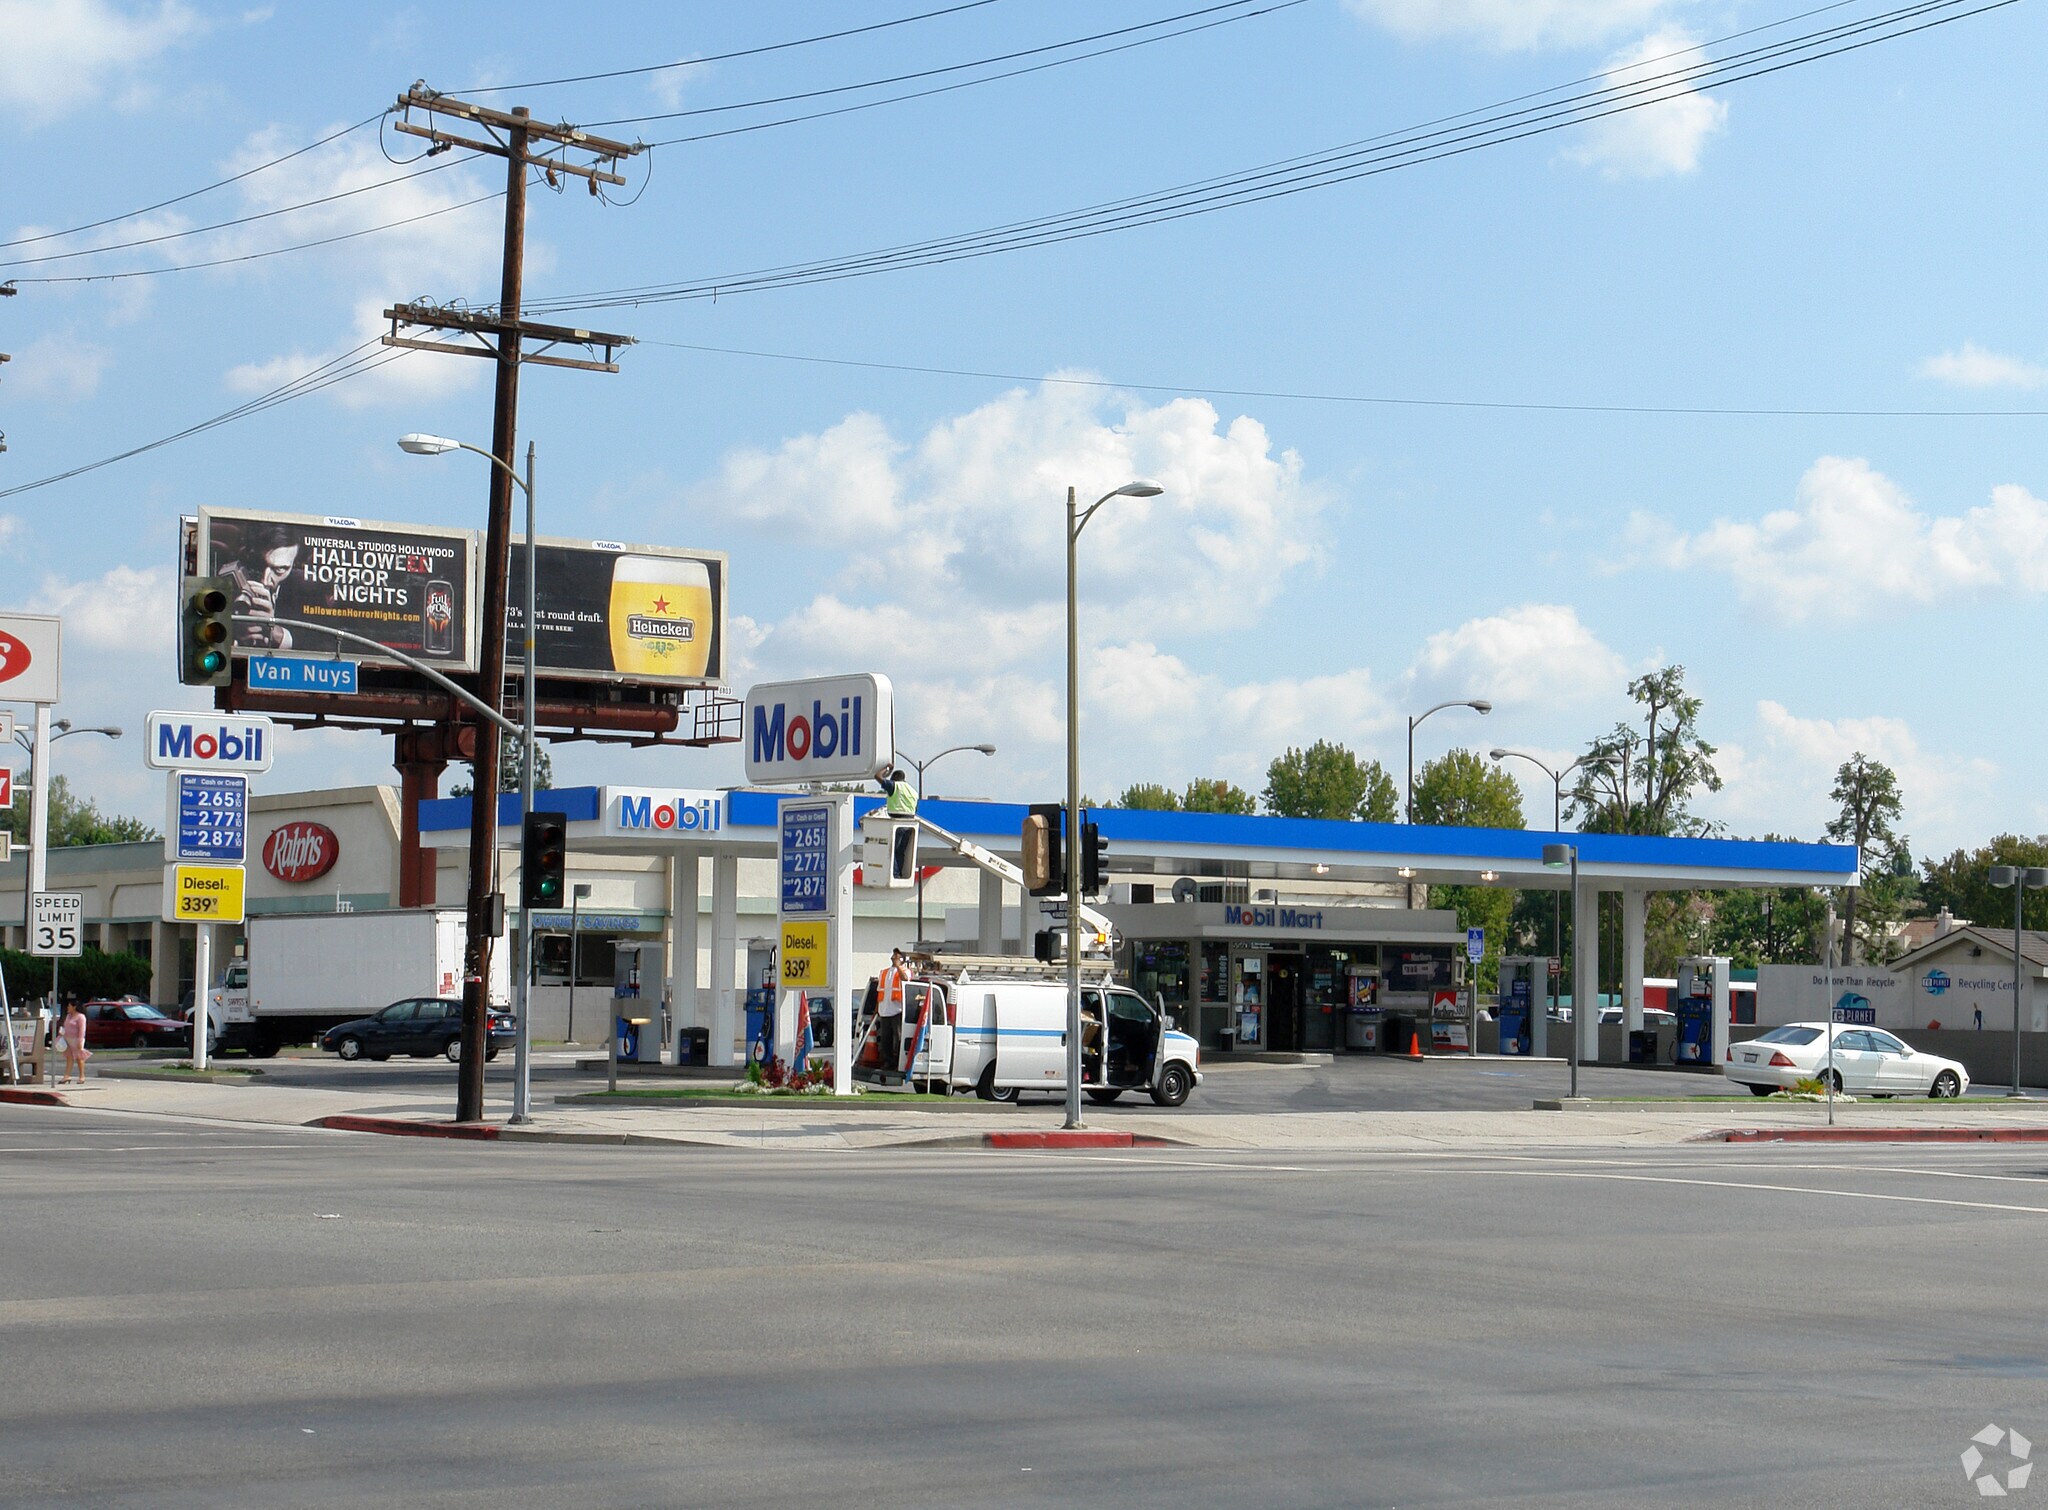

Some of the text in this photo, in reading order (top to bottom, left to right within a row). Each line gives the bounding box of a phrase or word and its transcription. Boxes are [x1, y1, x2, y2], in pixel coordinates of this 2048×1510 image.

[329, 518, 356, 526] VIACOM
[304, 536, 455, 558] UNIVERSAL STUDIOS HOLLYWOOD
[313, 547, 433, 573] HALLOWEEN
[303, 564, 389, 587] HORROR
[333, 583, 408, 606] NIGHTS
[303, 604, 420, 622] HalloweenHorrorNights.com
[547, 610, 575, 621] round
[577, 611, 604, 623] draft.
[632, 619, 690, 637] Heineken
[255, 661, 351, 688] Van Nuys
[753, 695, 862, 763] Mobil
[159, 723, 263, 762] Mobil
[198, 790, 235, 807] 2.65
[198, 810, 235, 827] 2.77
[619, 795, 721, 831] Mobil
[197, 830, 235, 847] 2.87
[795, 828, 820, 847] 2.65
[181, 849, 211, 857] Gasoline
[269, 826, 324, 877] Ralphs
[794, 853, 820, 871] 2.77
[184, 877, 224, 890] Diesel
[794, 876, 820, 896] 2.87
[35, 898, 80, 908] SPEED
[39, 912, 75, 922] LIMIT
[532, 913, 641, 929] OWNEY SAVINGS
[1225, 905, 1323, 929] Mobil Mart
[37, 927, 76, 949] 35
[785, 934, 814, 949] Diesel
[1812, 975, 1823, 985] Do
[1846, 976, 1863, 986] Than
[1866, 977, 1895, 988] Recycle
[1958, 978, 2024, 991] Recycling Centr
